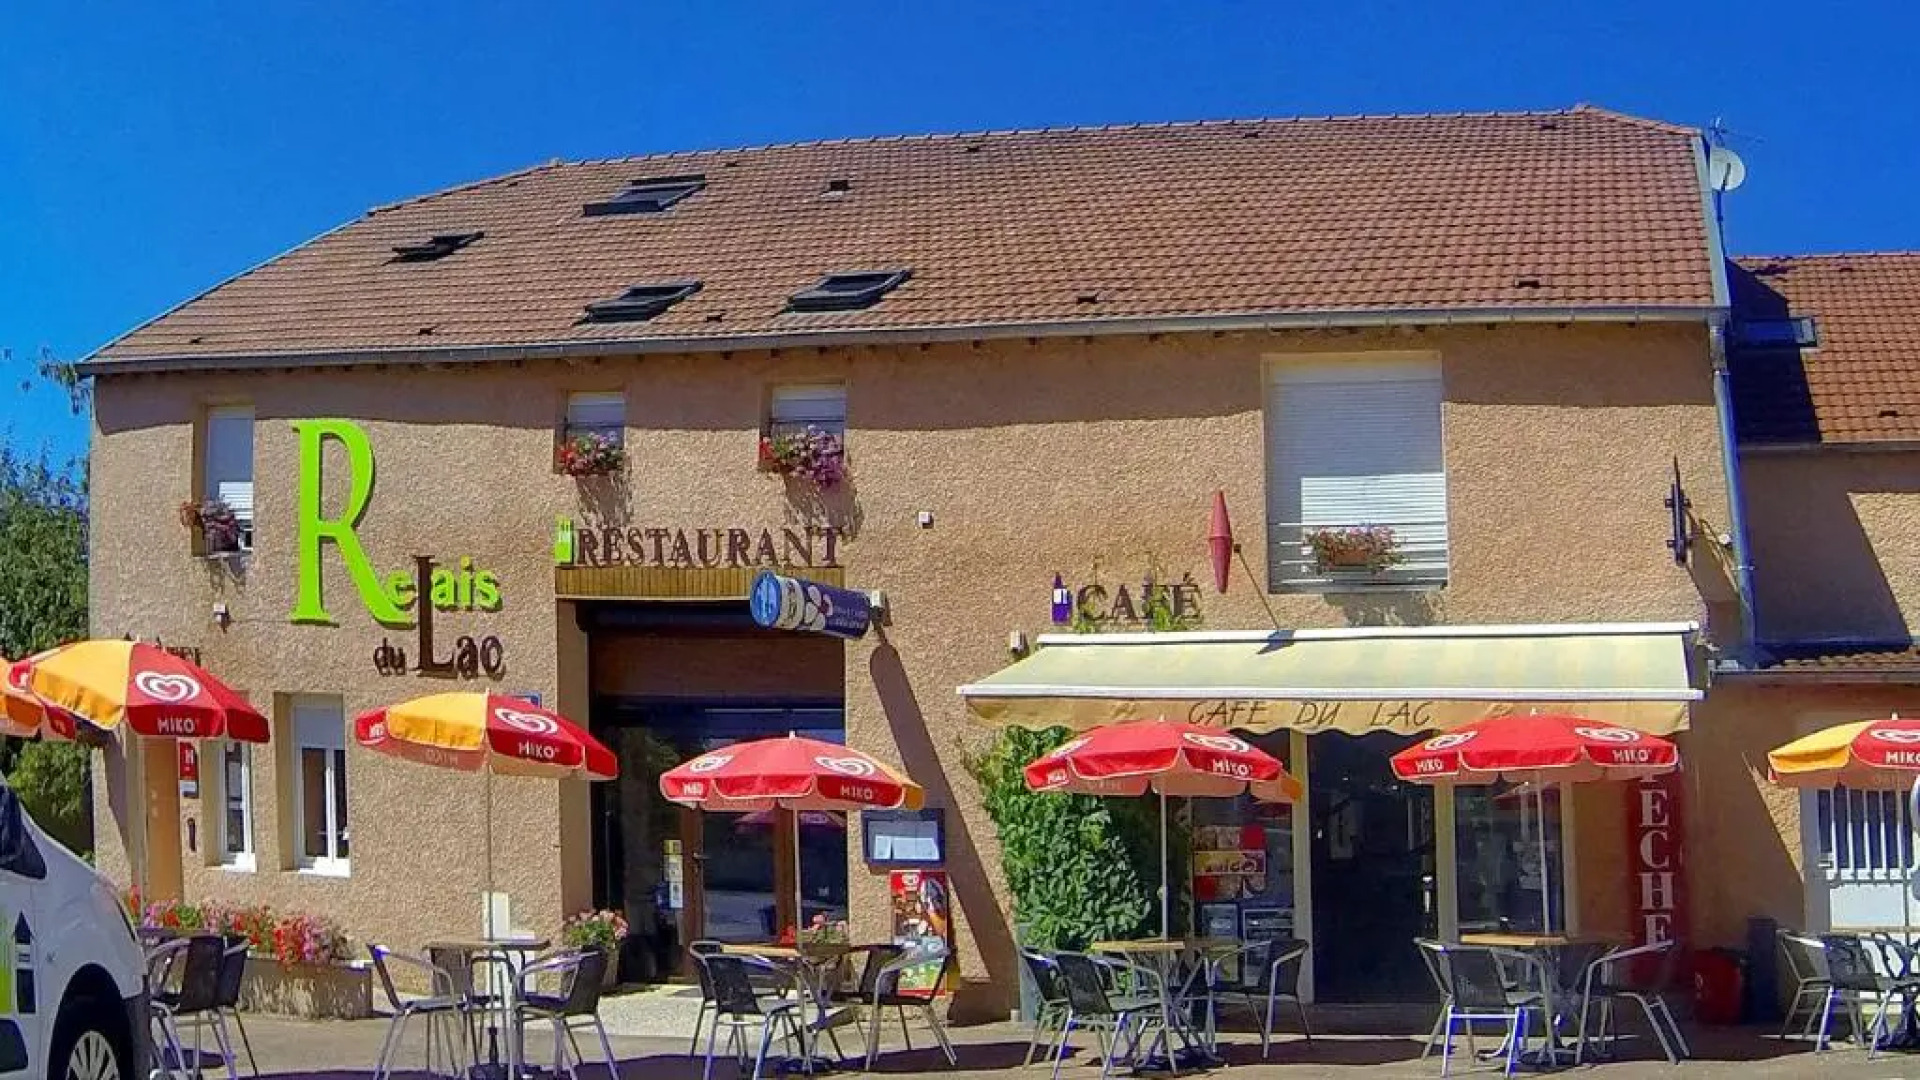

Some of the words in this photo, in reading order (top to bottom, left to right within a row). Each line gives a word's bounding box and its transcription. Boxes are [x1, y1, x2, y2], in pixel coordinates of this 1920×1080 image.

[577, 527, 843, 568] RESTAURANT
[373, 637, 406, 675] du
[409, 555, 505, 678] Lac
[1187, 701, 1268, 726] CAFE
[1293, 702, 1342, 727] DU
[1369, 702, 1431, 727] LAC
[157, 717, 195, 733] MIKO
[518, 741, 556, 759] MIKO
[1611, 749, 1649, 762] MIKO
[1212, 758, 1249, 776] MIKO
[840, 785, 874, 800] MIKO
[1638, 774, 1675, 948] ECHE
